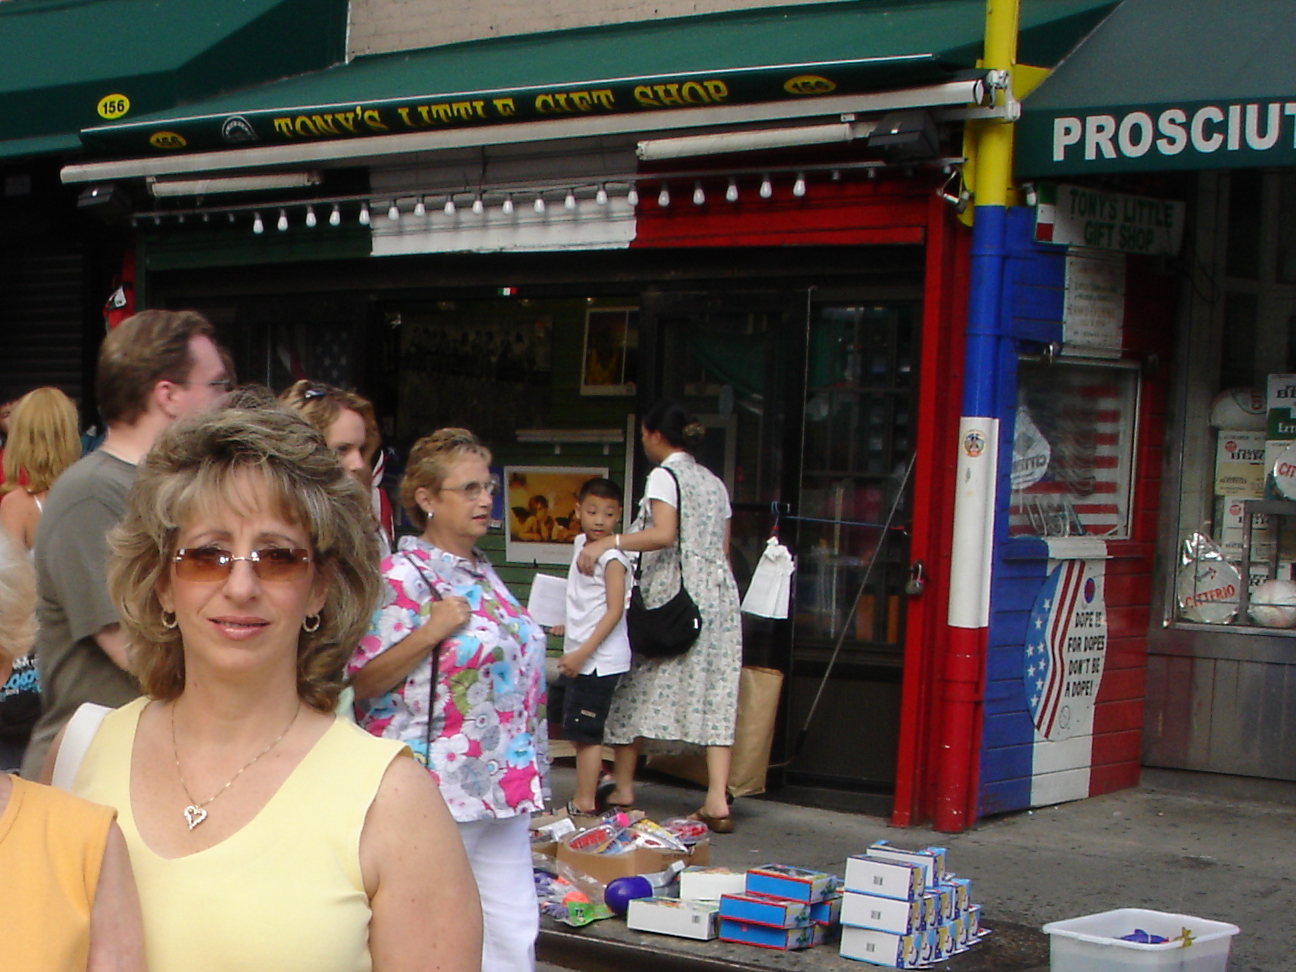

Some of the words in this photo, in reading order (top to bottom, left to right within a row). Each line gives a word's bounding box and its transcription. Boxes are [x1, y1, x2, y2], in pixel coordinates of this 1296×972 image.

[102, 99, 125, 115] 156
[1124, 196, 1174, 228] LITTLE
[1084, 219, 1114, 247] GIFT
[1118, 224, 1153, 249] SHOP
[1075, 611, 1094, 628] DOPE
[1067, 637, 1082, 653] FOR
[1083, 635, 1105, 651] DOPES
[1068, 659, 1090, 676] DON'T
[1091, 657, 1101, 673] BE
[1065, 685, 1070, 697] A
[1071, 682, 1093, 698] DOPE!
